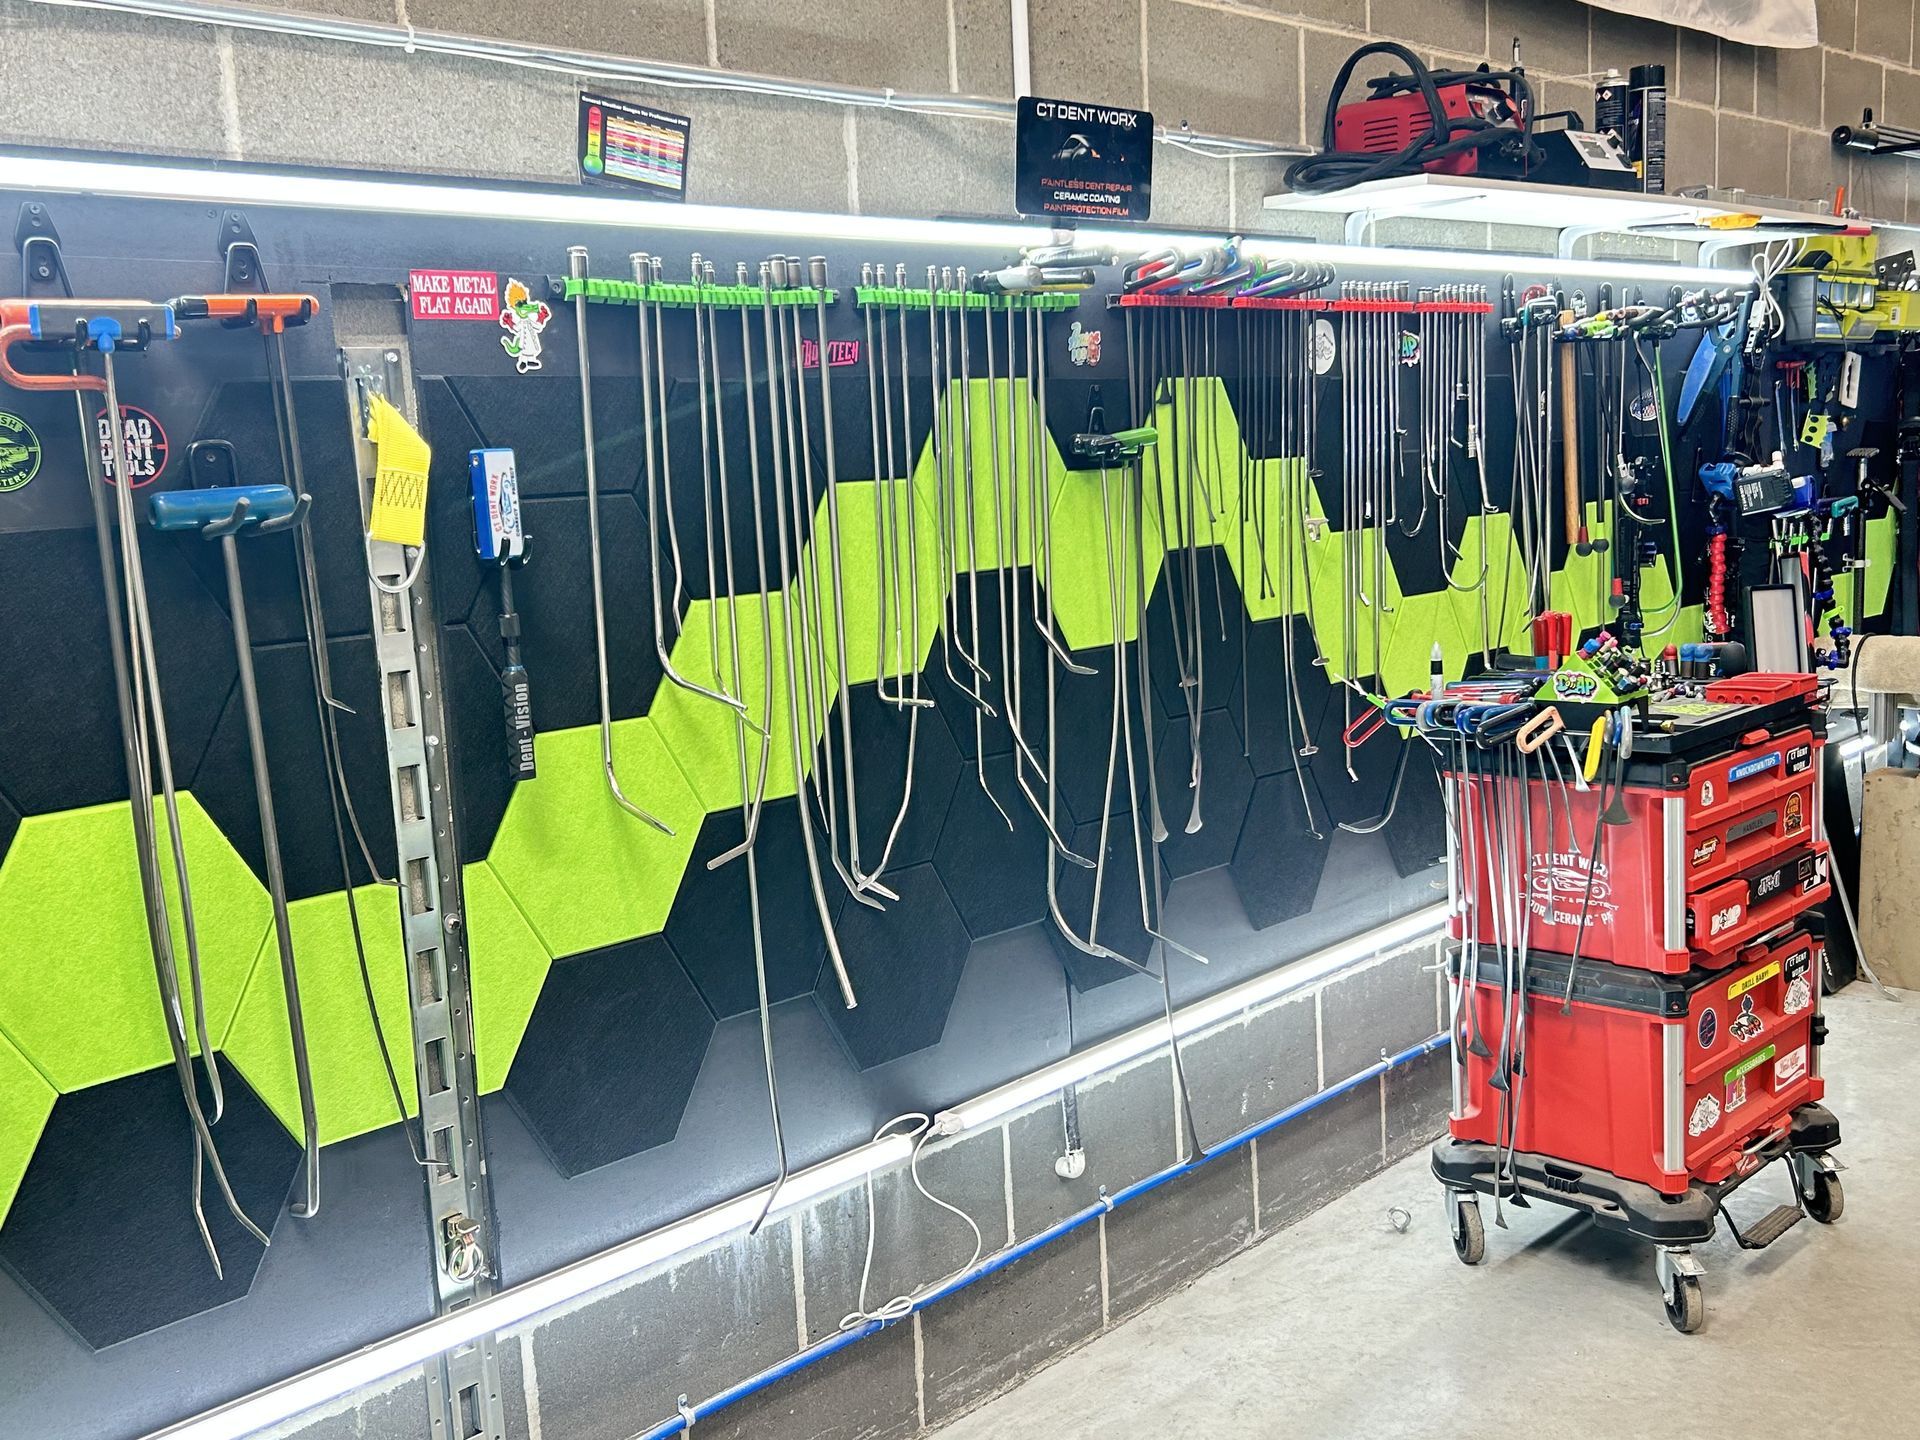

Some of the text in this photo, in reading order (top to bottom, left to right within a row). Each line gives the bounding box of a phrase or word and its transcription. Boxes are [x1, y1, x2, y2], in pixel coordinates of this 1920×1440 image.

[649, 111, 677, 124] Professional
[1036, 102, 1137, 128] CT DENT WORX
[1041, 177, 1132, 193] PAINTLESS DENT REPAIR
[1053, 191, 1121, 205] CERAMIC COATING
[1112, 206, 1129, 216] FILM
[411, 274, 496, 295] MAKE METAL
[419, 296, 493, 315] FLAT AGAIN
[98, 419, 152, 440] DAD
[99, 438, 153, 461] DNT
[101, 459, 156, 476] TOLS
[1741, 977, 1755, 991] DRILL
[1736, 1052, 1766, 1076] ACCESSORIES
